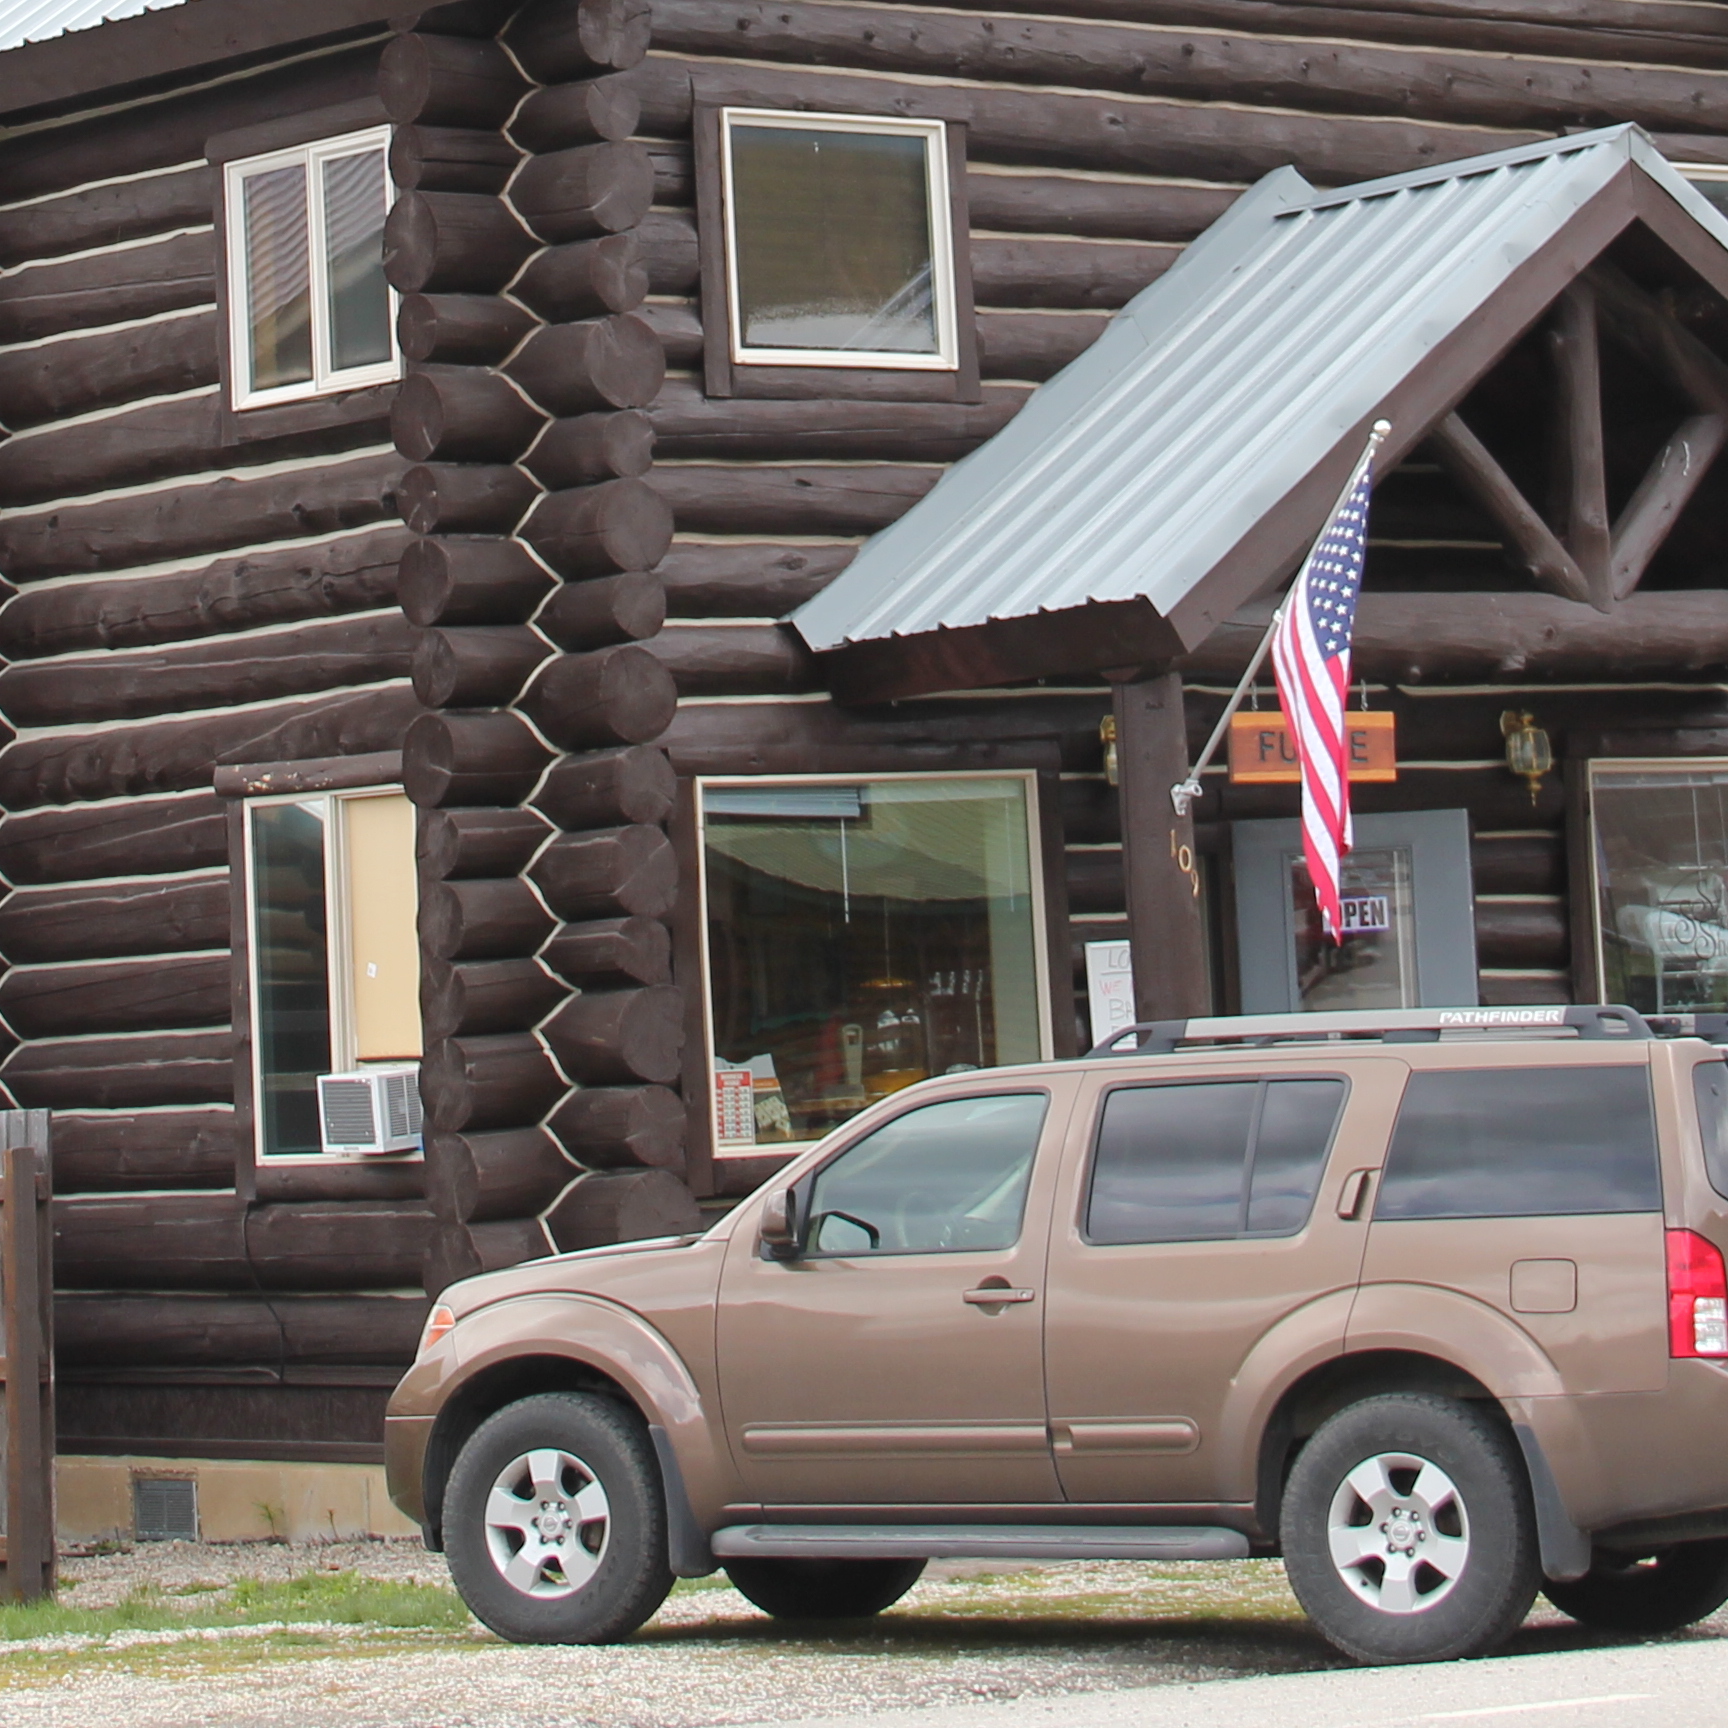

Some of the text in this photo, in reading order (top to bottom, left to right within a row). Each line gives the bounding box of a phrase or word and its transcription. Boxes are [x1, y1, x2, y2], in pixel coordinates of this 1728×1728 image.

[1259, 731, 1368, 764] FUE
[1339, 899, 1386, 929] PEN
[1439, 1010, 1559, 1024] PATHFINDER
